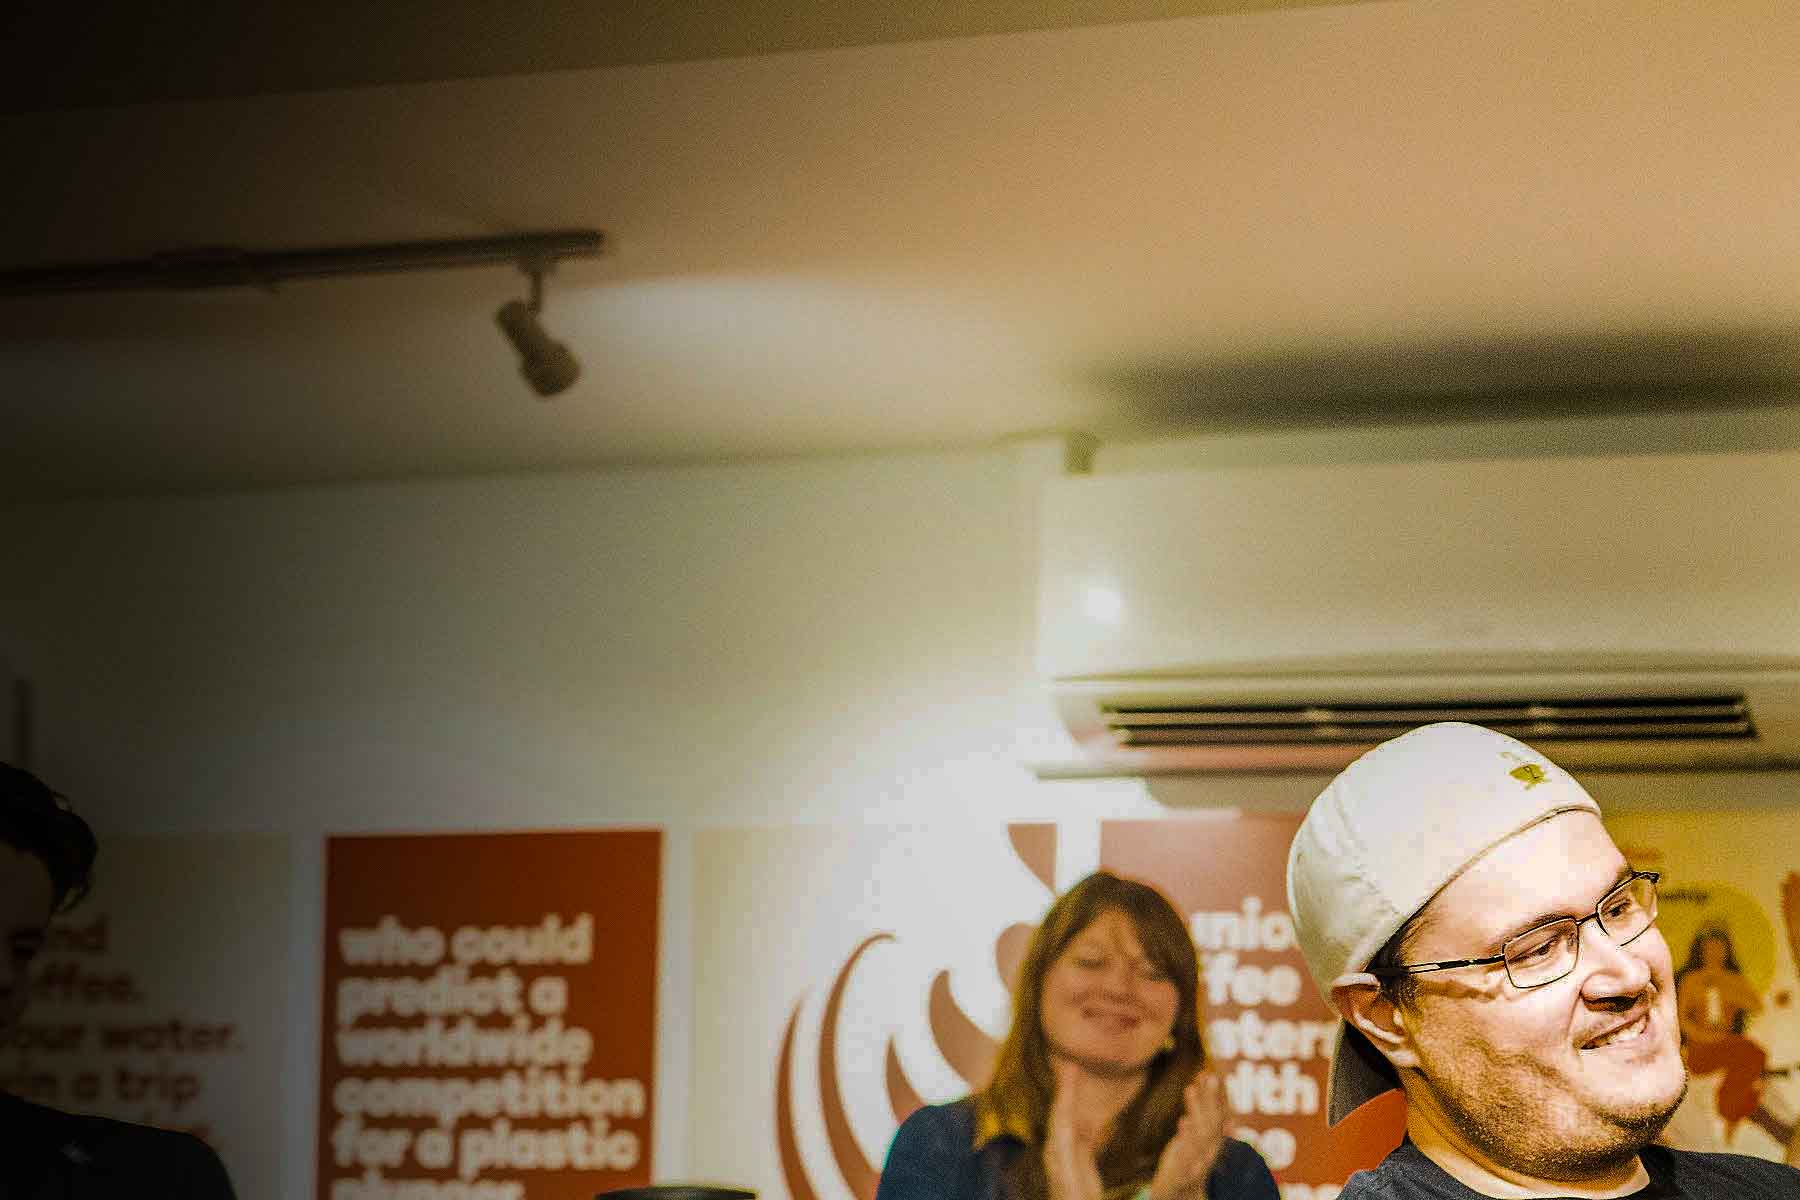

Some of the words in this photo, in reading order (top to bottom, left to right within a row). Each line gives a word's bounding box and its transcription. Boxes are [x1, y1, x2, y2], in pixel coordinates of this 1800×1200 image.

[337, 914, 445, 966] who
[452, 911, 594, 965] could
[337, 963, 522, 1027] predict
[528, 976, 568, 1016] a
[336, 1013, 593, 1067] worldwide
[334, 1064, 645, 1128] competition
[331, 1112, 410, 1168] for
[416, 1127, 453, 1169] a
[458, 1116, 640, 1180] plastic
